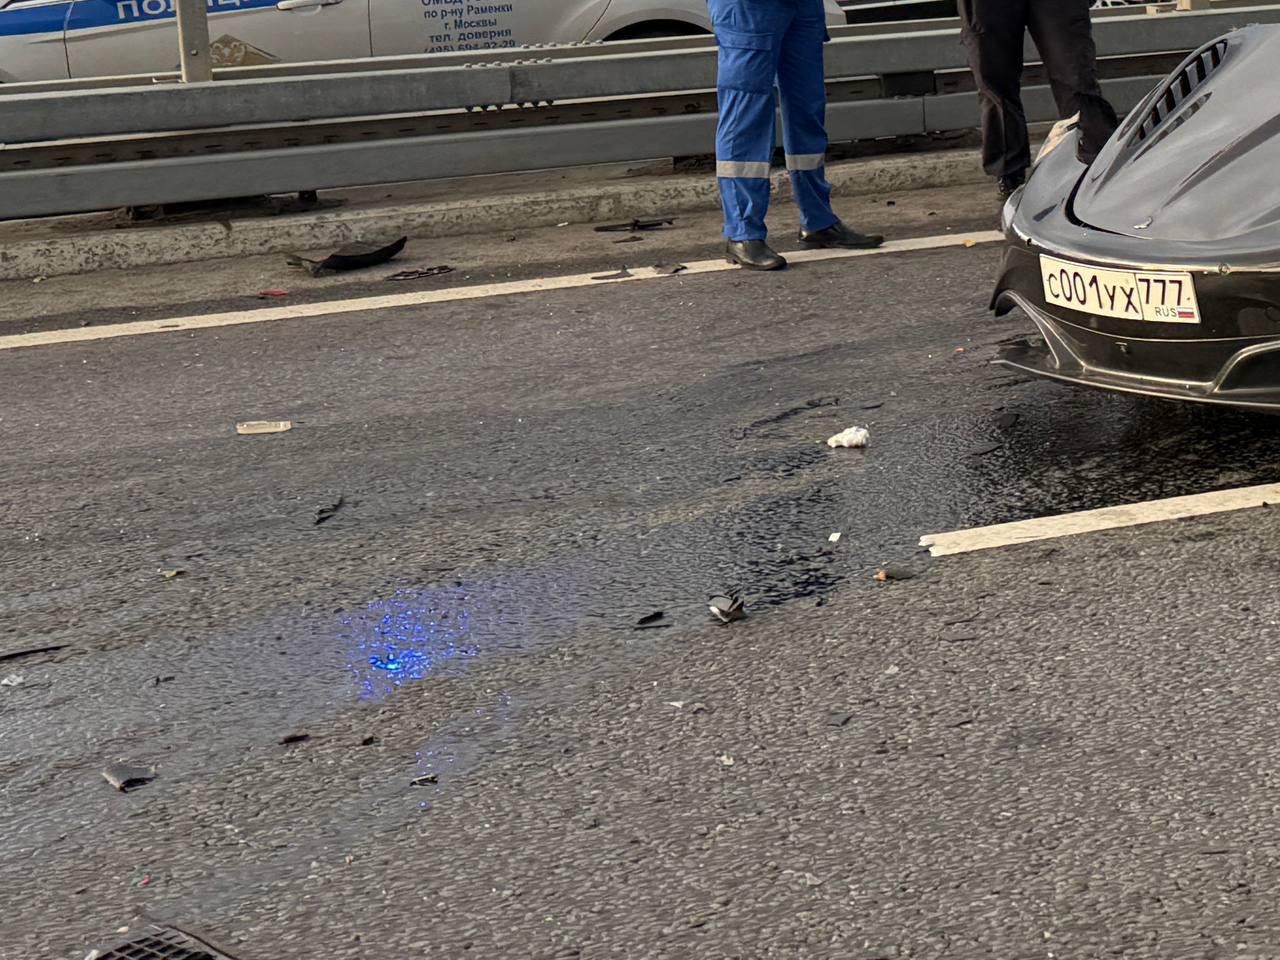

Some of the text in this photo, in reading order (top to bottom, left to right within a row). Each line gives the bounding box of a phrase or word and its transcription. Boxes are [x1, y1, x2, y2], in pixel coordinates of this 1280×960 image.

[424, 4, 513, 20] по р-ну Раменки
[454, 18, 497, 30] Москвы
[458, 28, 512, 41] доверия
[1155, 306, 1177, 317] RUS
